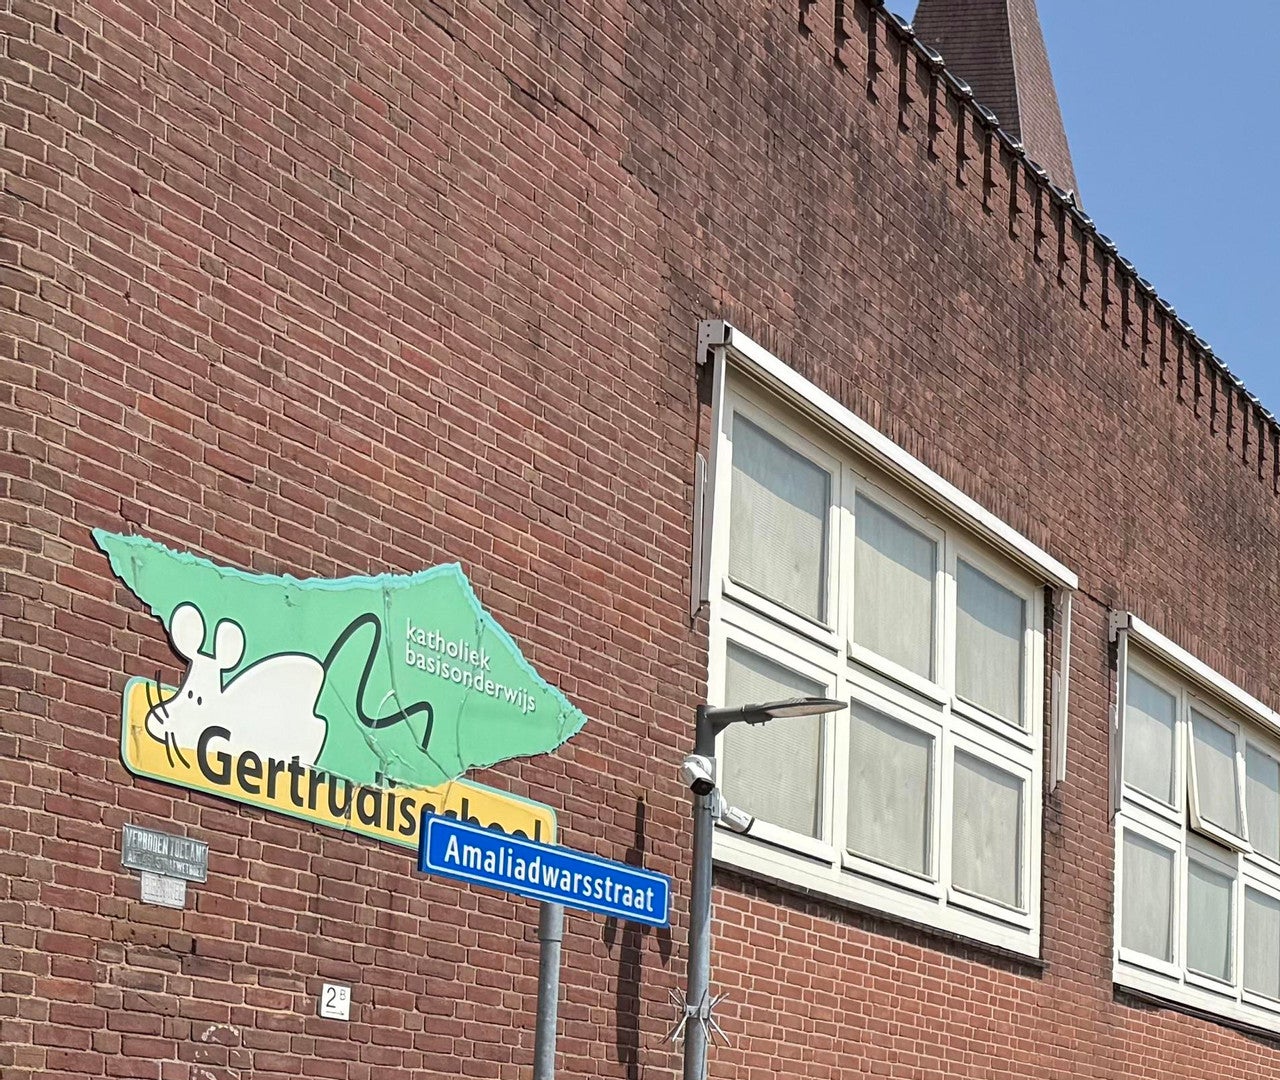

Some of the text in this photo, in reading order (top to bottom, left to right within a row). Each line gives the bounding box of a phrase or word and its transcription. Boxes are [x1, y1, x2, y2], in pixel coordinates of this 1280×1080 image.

[405, 643, 536, 714] basisonderwijs
[406, 617, 491, 670] katholiek
[197, 726, 541, 842] Gertrudis
[444, 835, 654, 912] Amaliadwarsstraat
